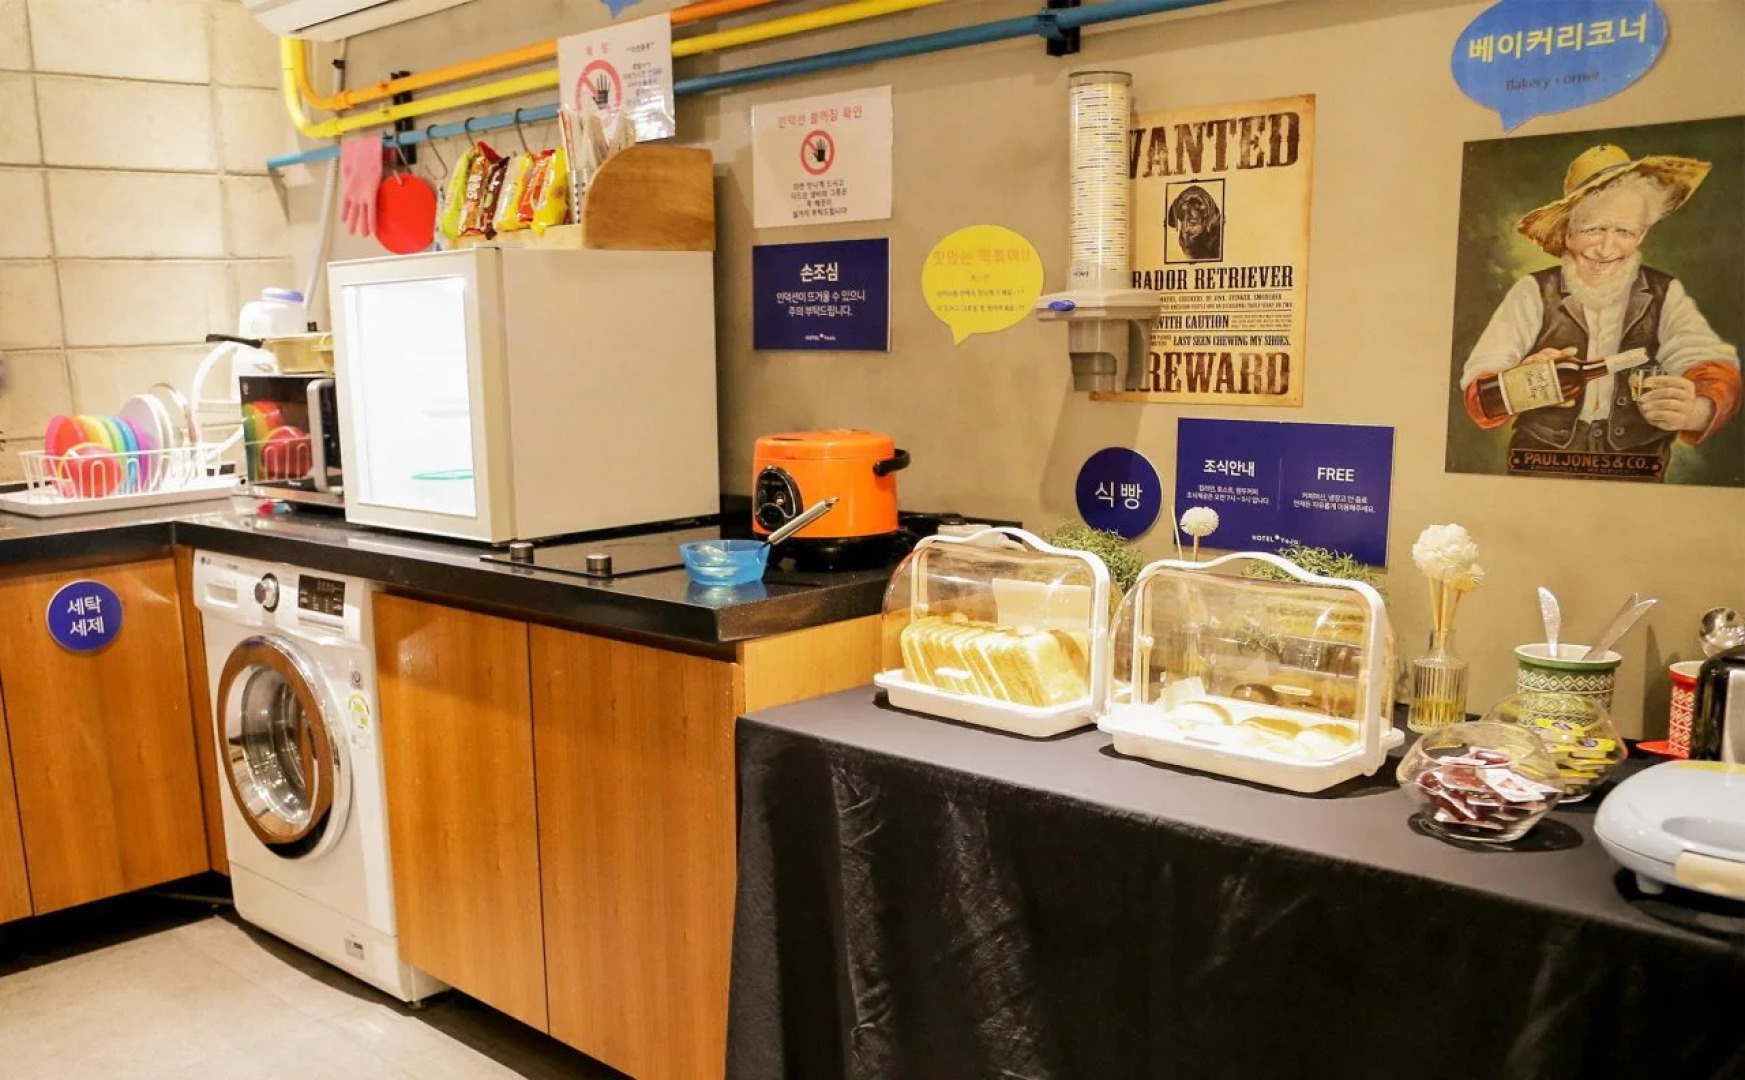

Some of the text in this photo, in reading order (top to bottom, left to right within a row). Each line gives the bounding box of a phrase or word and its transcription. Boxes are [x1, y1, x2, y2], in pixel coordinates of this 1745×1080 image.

[1469, 13, 1648, 63] 베이커리코너
[1506, 72, 1600, 92] Bakery corner
[800, 262, 838, 283] 손조심
[1194, 266, 1293, 289] RETRIEVER
[776, 289, 866, 304] 인덕션이 뜨거울 수 있으니
[788, 306, 804, 317] 주의
[1186, 315, 1229, 329] CAUTION
[1173, 335, 1191, 346] LAST
[1193, 335, 1212, 346] SEEN
[1213, 335, 1249, 346] CHEWING
[1250, 335, 1263, 346] MY
[1203, 459, 1255, 477] 조식안내
[1524, 452, 1560, 466] PAUL
[1562, 453, 1611, 468] JONES
[1613, 456, 1625, 469] &
[1626, 456, 1649, 469] CO.
[1317, 466, 1355, 482] FREE
[1094, 481, 1143, 510] 식빵
[67, 595, 102, 615] 세탁
[69, 616, 104, 636] 세제
